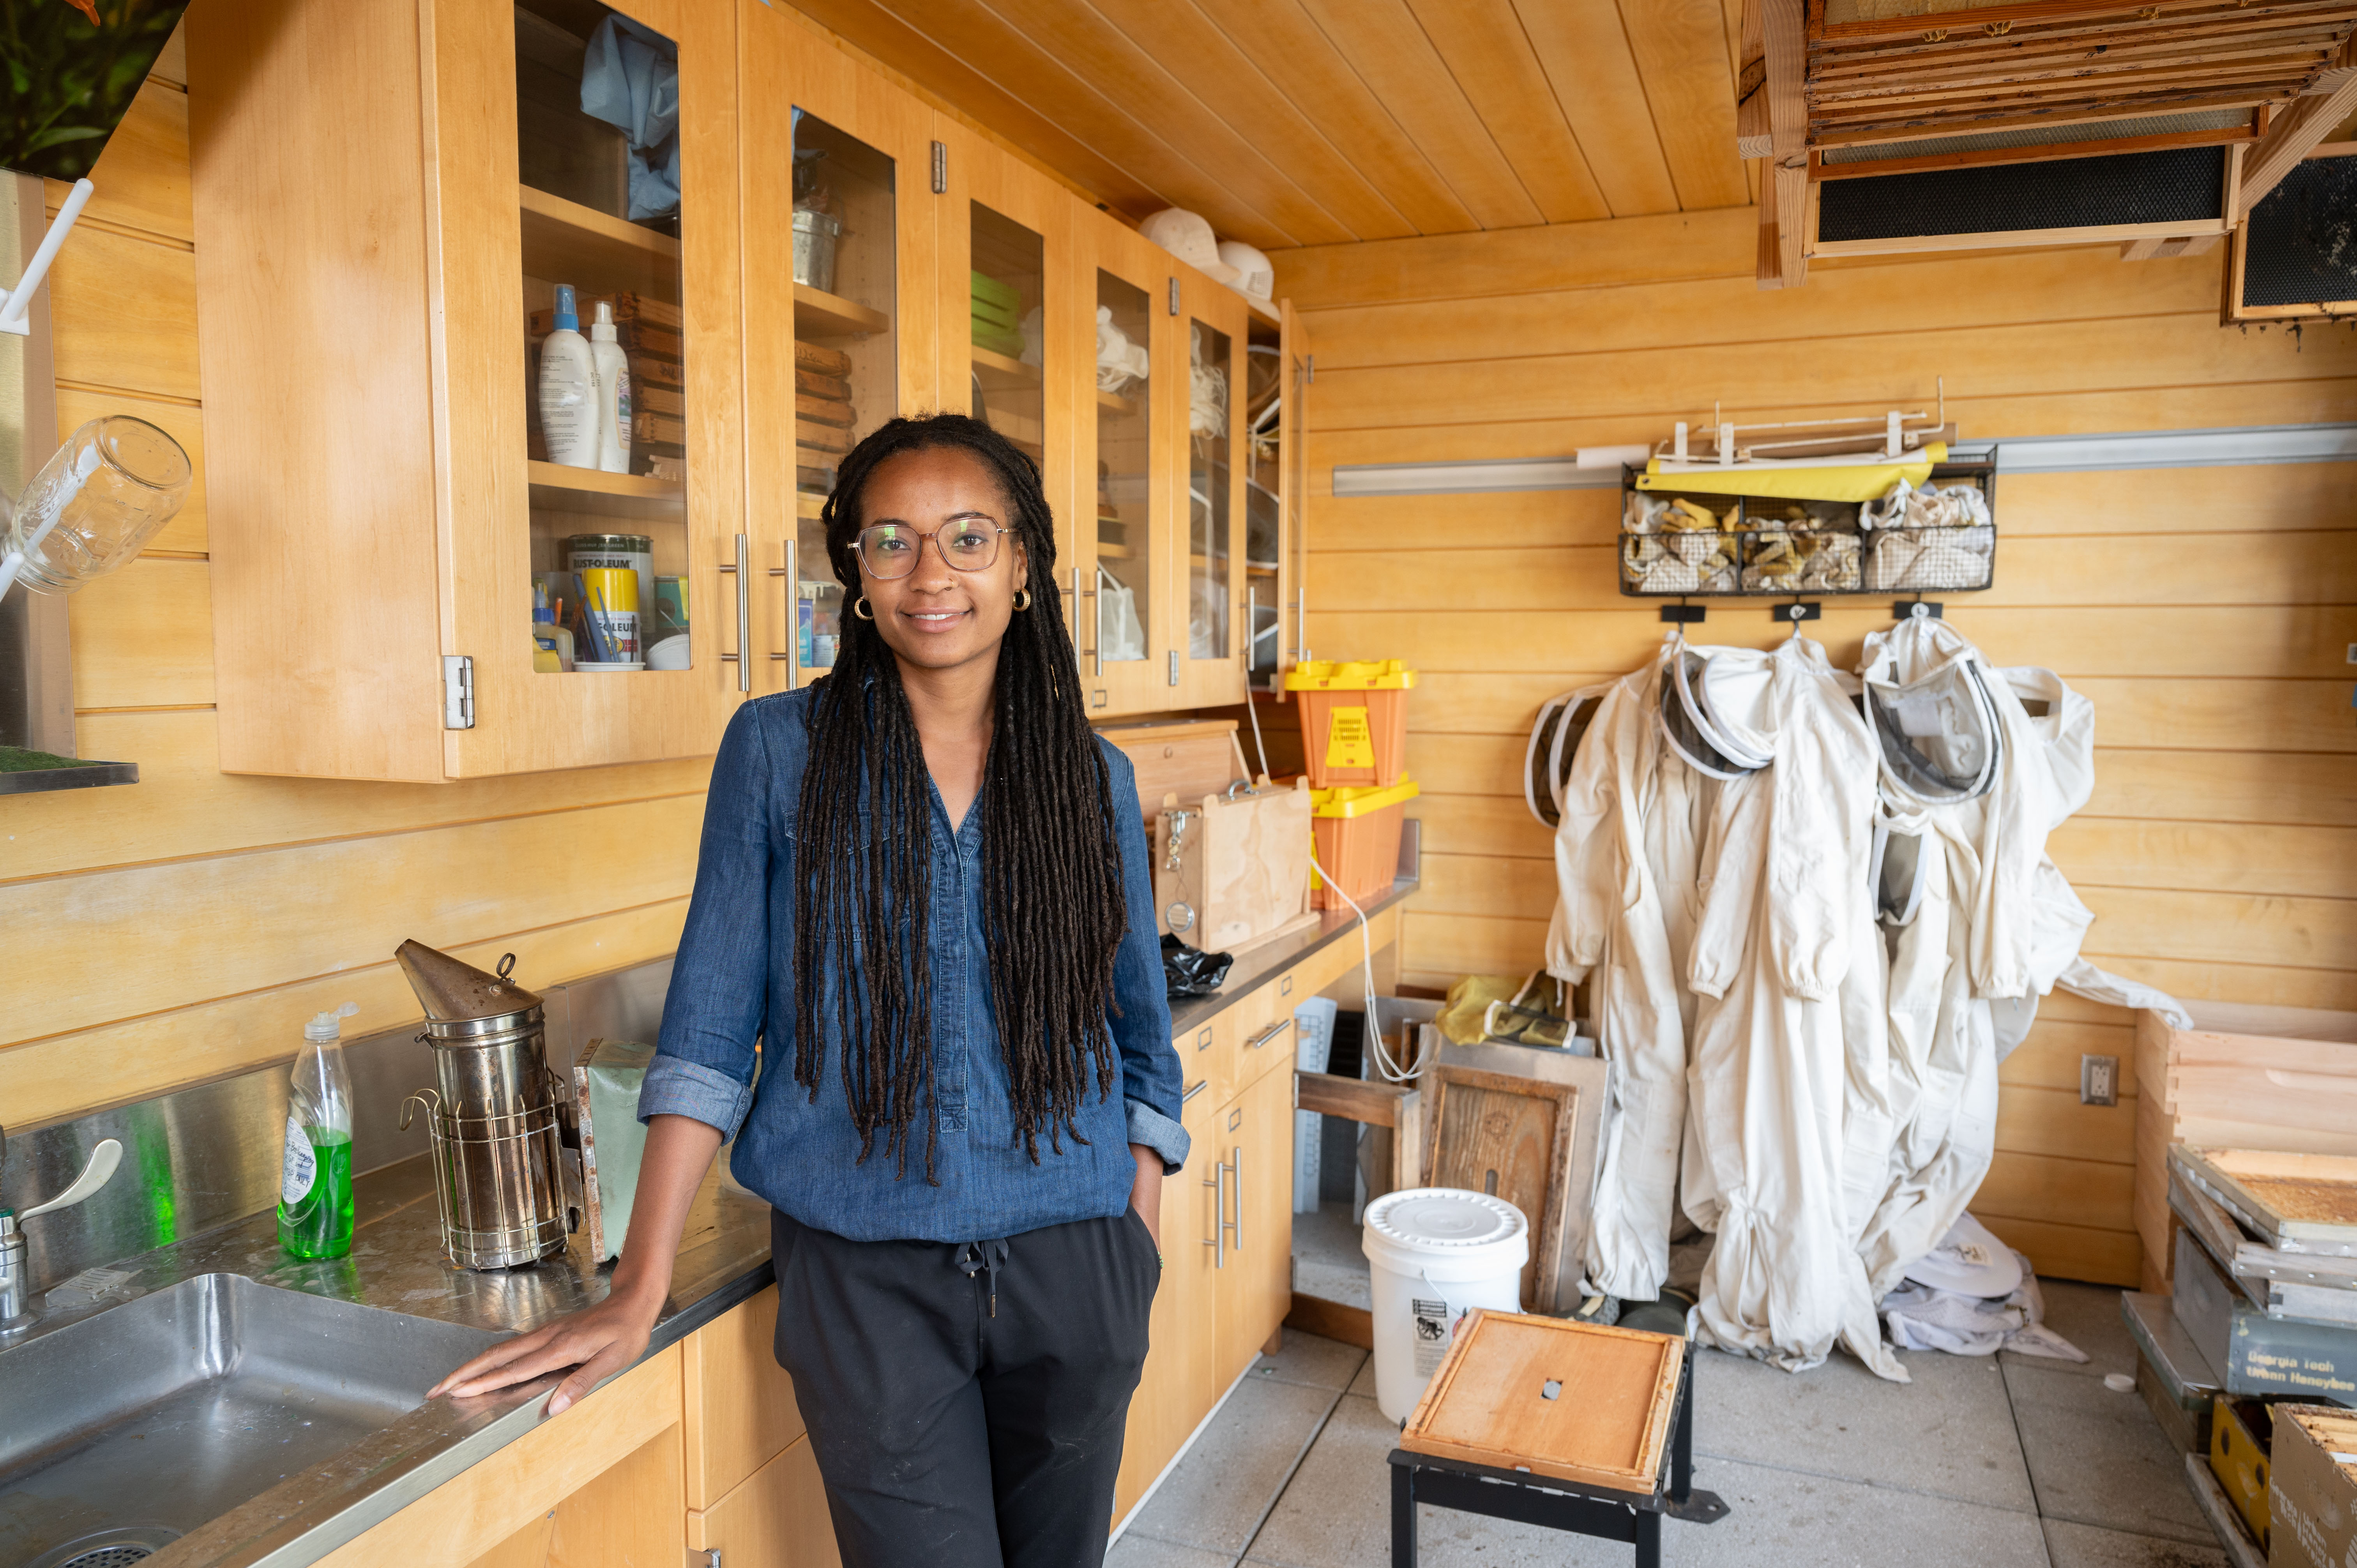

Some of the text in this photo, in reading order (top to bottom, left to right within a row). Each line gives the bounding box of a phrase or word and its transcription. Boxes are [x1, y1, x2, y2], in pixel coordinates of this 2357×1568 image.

[2247, 1350, 2335, 1373] Georgia Tech
[2290, 1371, 2356, 1391] Honeybee
